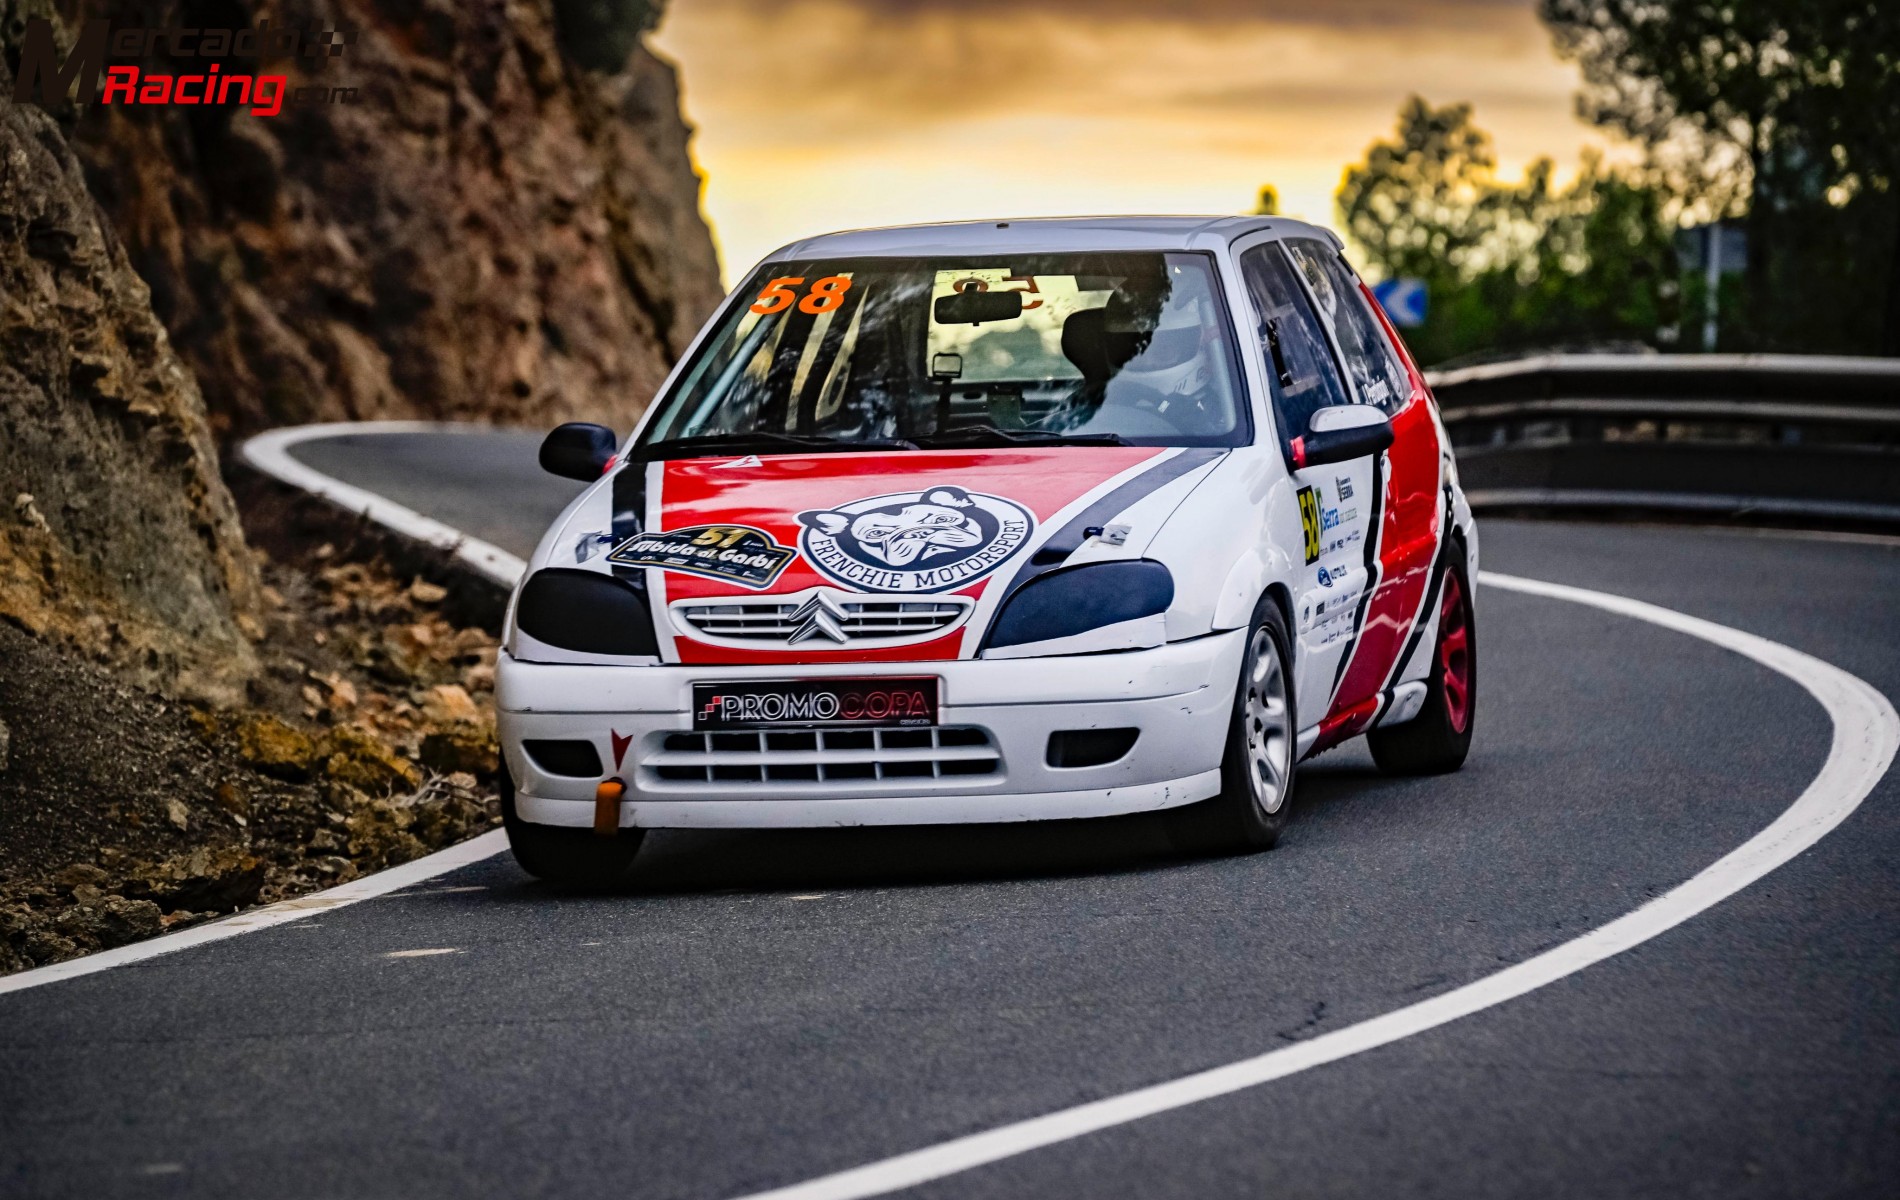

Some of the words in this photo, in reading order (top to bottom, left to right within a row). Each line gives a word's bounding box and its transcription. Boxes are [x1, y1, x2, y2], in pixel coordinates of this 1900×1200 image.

[750, 276, 852, 314] 58
[691, 527, 750, 548] 51
[1299, 490, 1319, 561] 58
[626, 540, 697, 556] Subida
[697, 549, 715, 558] al
[811, 539, 903, 589] FRENCHIE
[913, 519, 1024, 588] MOTORSPORT
